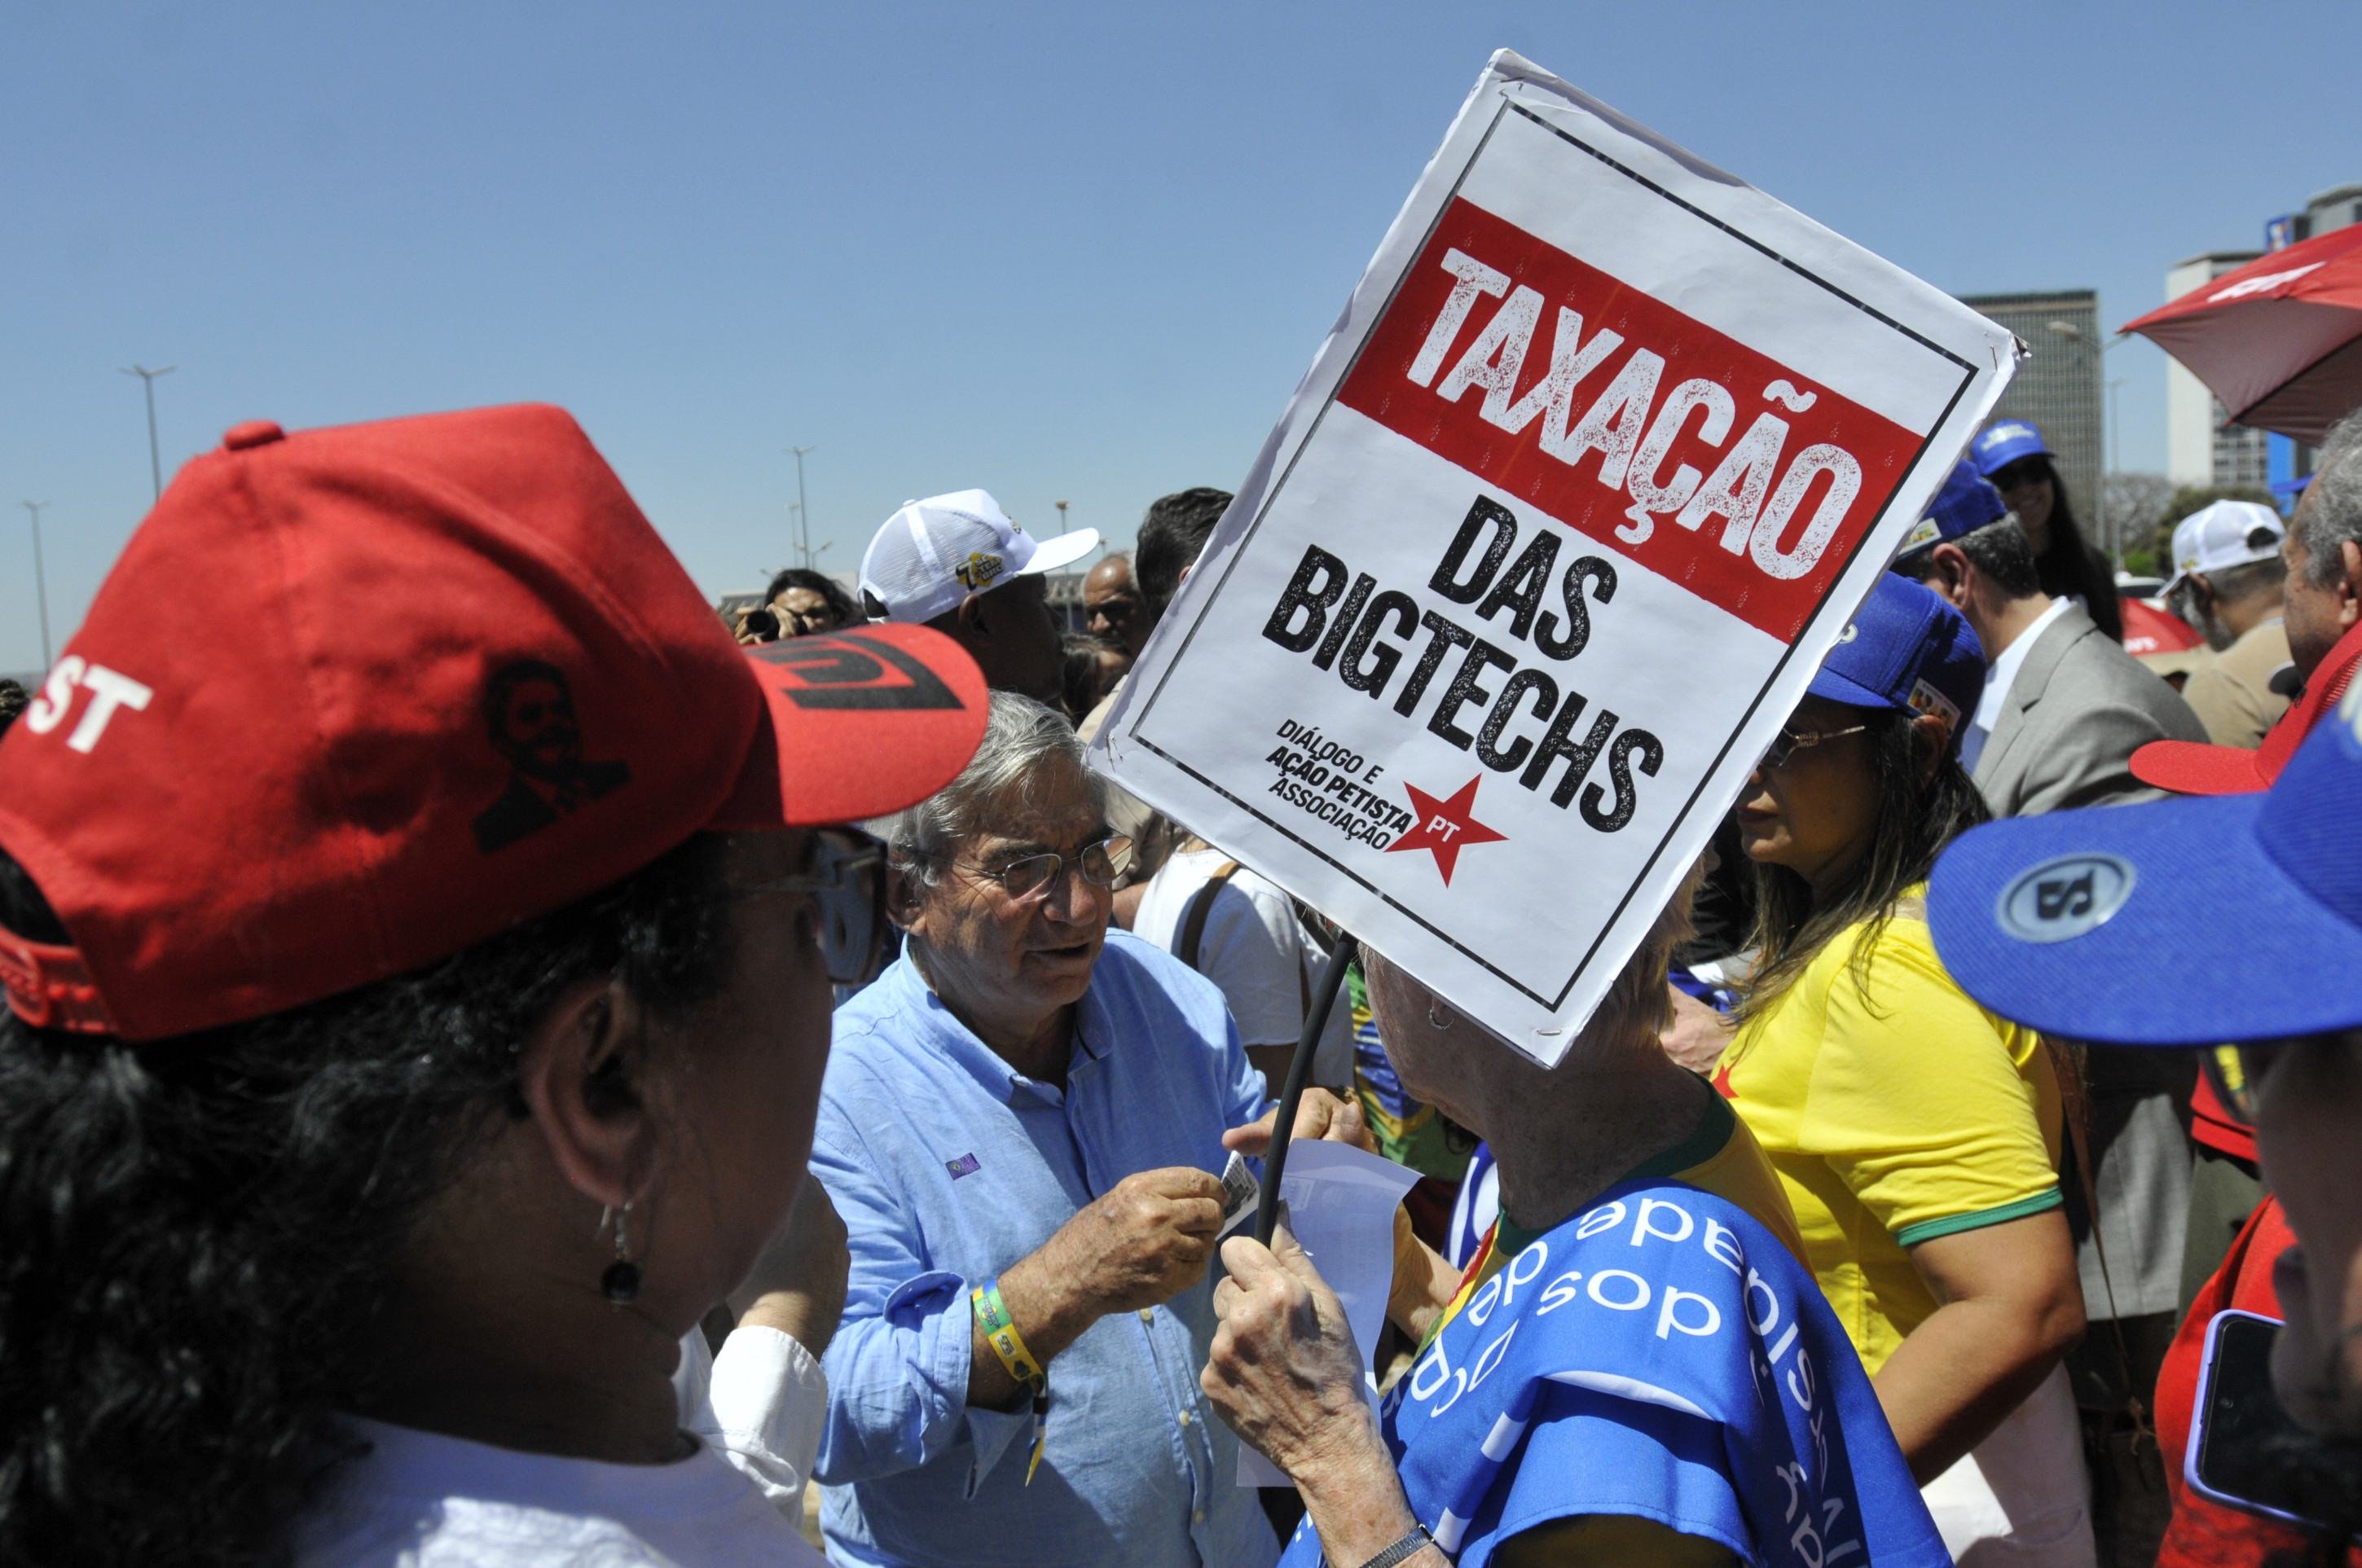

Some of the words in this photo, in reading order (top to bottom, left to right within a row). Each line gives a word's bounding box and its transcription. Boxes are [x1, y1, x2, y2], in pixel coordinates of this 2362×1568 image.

[1407, 247, 1863, 580] TAXAÇÃO
[956, 560, 977, 591] 7
[1428, 494, 1617, 661] DAS
[1261, 543, 1664, 832] BIGTECHS
[1265, 745, 1329, 786] AÇÃO
[1323, 775, 1414, 835] PETISTA
[1276, 718, 1364, 774] DIÁLOGO
[1362, 764, 1384, 784] E
[1268, 777, 1391, 850] ASSOCIAÇÃO
[1426, 815, 1461, 843] PT
[1467, 1240, 1549, 1327] de
[1535, 1268, 1722, 1341] dos
